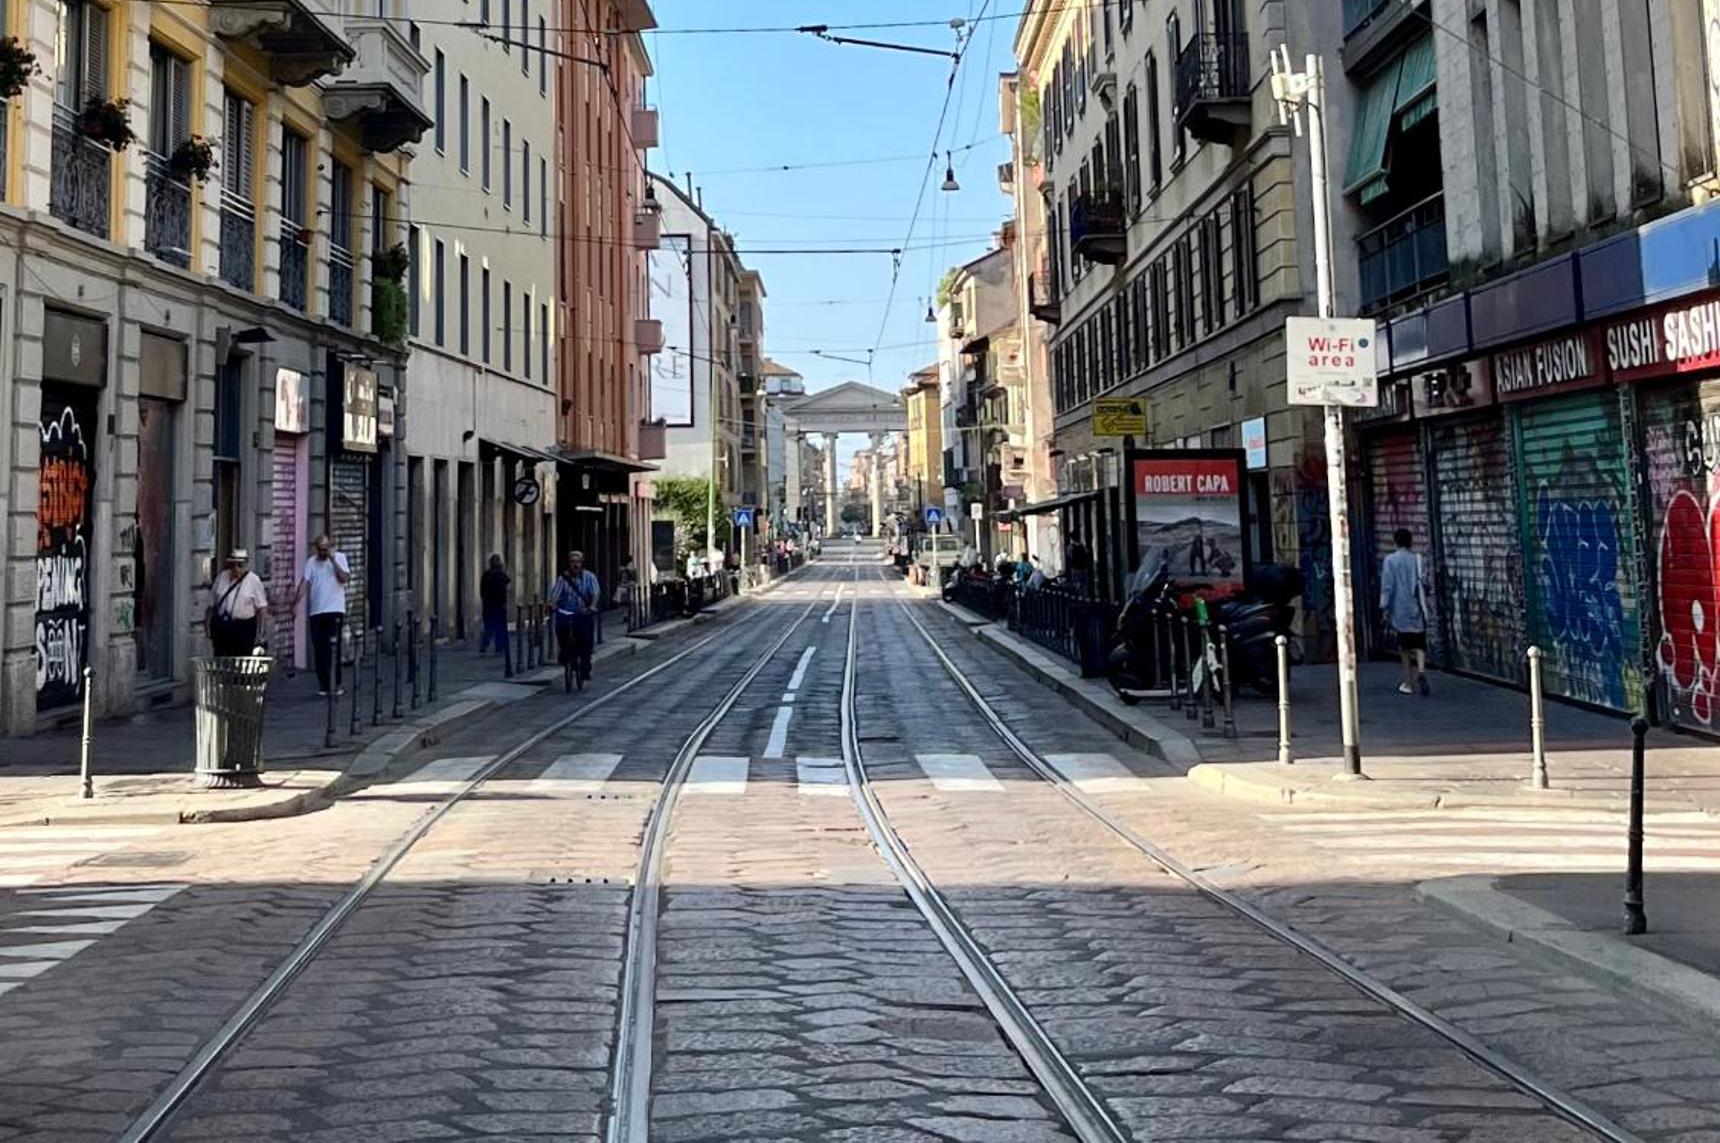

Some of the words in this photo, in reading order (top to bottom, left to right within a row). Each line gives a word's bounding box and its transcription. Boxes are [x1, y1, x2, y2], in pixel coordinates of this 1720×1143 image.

[1308, 337, 1354, 352] Wi-Fi
[1607, 319, 1659, 371] SUSHI
[1308, 355, 1355, 367] area
[1496, 349, 1533, 393] ASIAN
[1535, 335, 1587, 387] FUSION
[1144, 474, 1193, 493] ROBERT
[1196, 474, 1229, 493] CAPA
